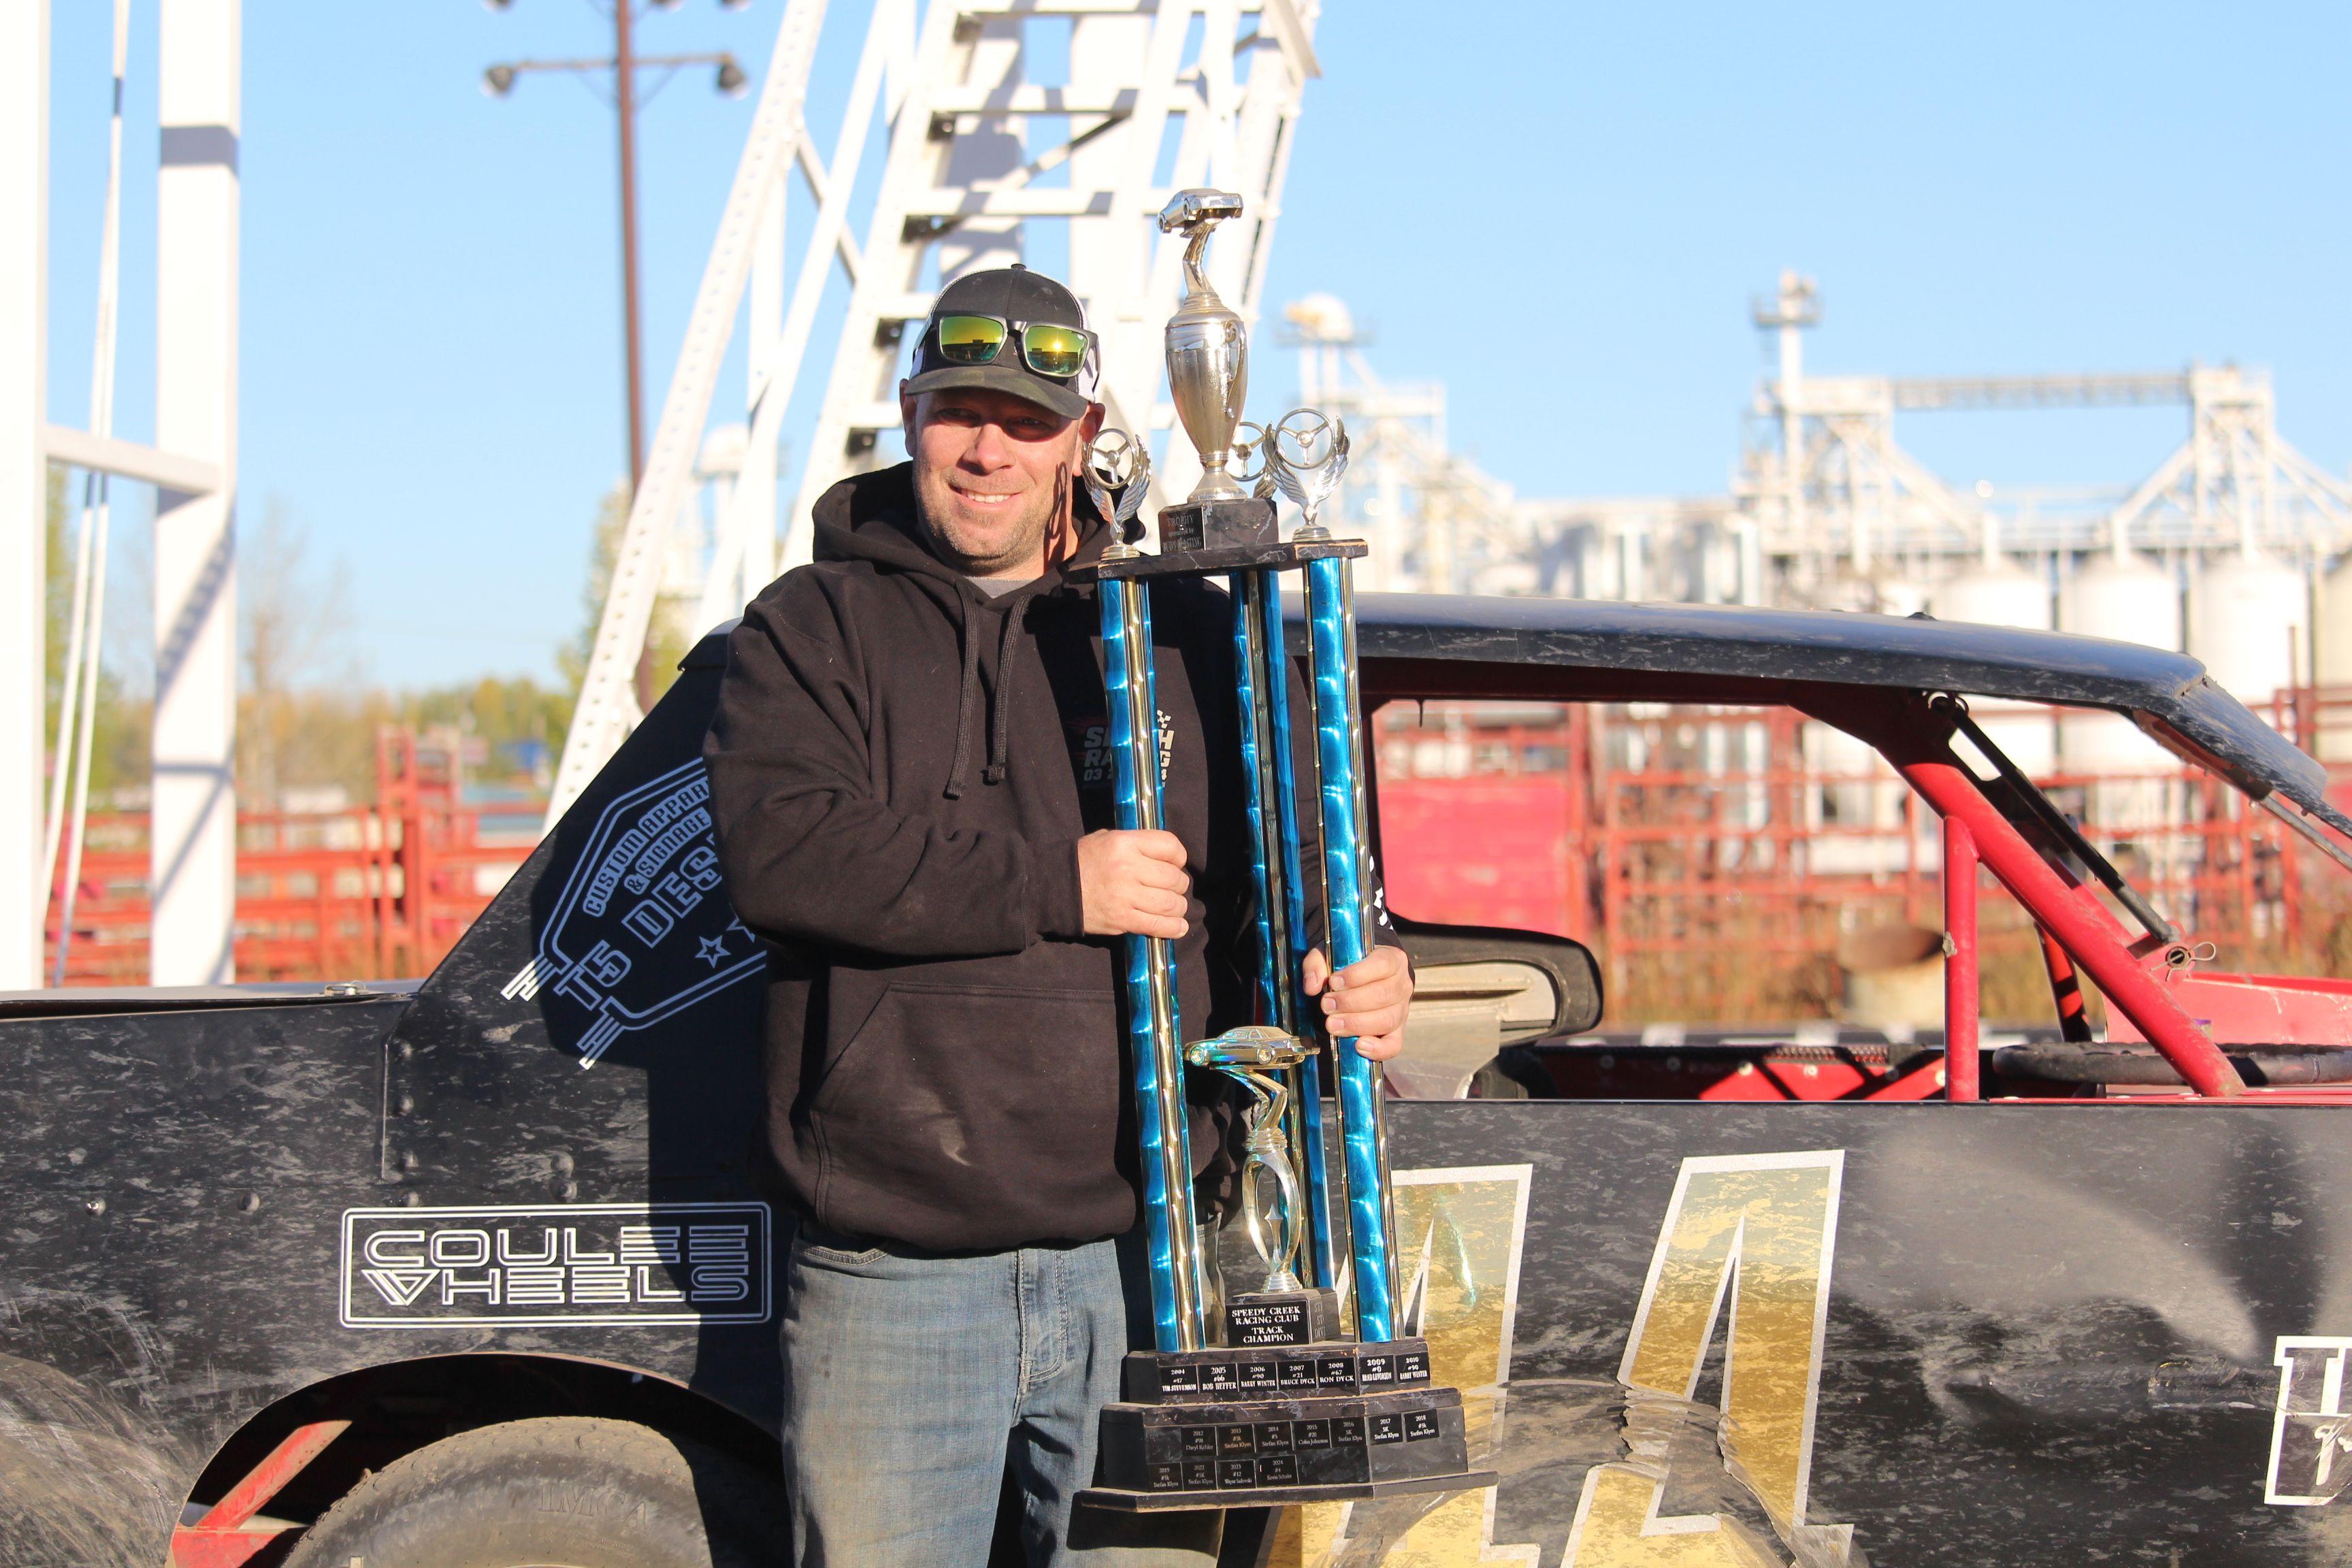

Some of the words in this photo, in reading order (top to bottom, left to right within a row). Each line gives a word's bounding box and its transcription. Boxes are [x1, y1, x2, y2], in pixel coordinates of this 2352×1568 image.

[1166, 514, 1194, 527] TROPHY
[635, 807, 712, 879] SIGNAGE
[583, 828, 649, 917] CUSTOM
[624, 875, 651, 896] &
[364, 1225, 749, 1268] COULEE
[361, 1264, 749, 1306] WHEELS
[1232, 1307, 1266, 1318] SPEEDY
[1269, 1306, 1301, 1316] CREEK
[1235, 1316, 1272, 1325] RACING
[1274, 1314, 1298, 1324] CLUB
[1252, 1326, 1284, 1335] TRACK
[1243, 1333, 1294, 1343] CHAMPION
[1211, 1367, 1226, 1375] 2005
[1400, 1372, 1411, 1380] BARRY
[1412, 1370, 1428, 1378] WINTER
[1362, 1373, 1372, 1382] BRAD
